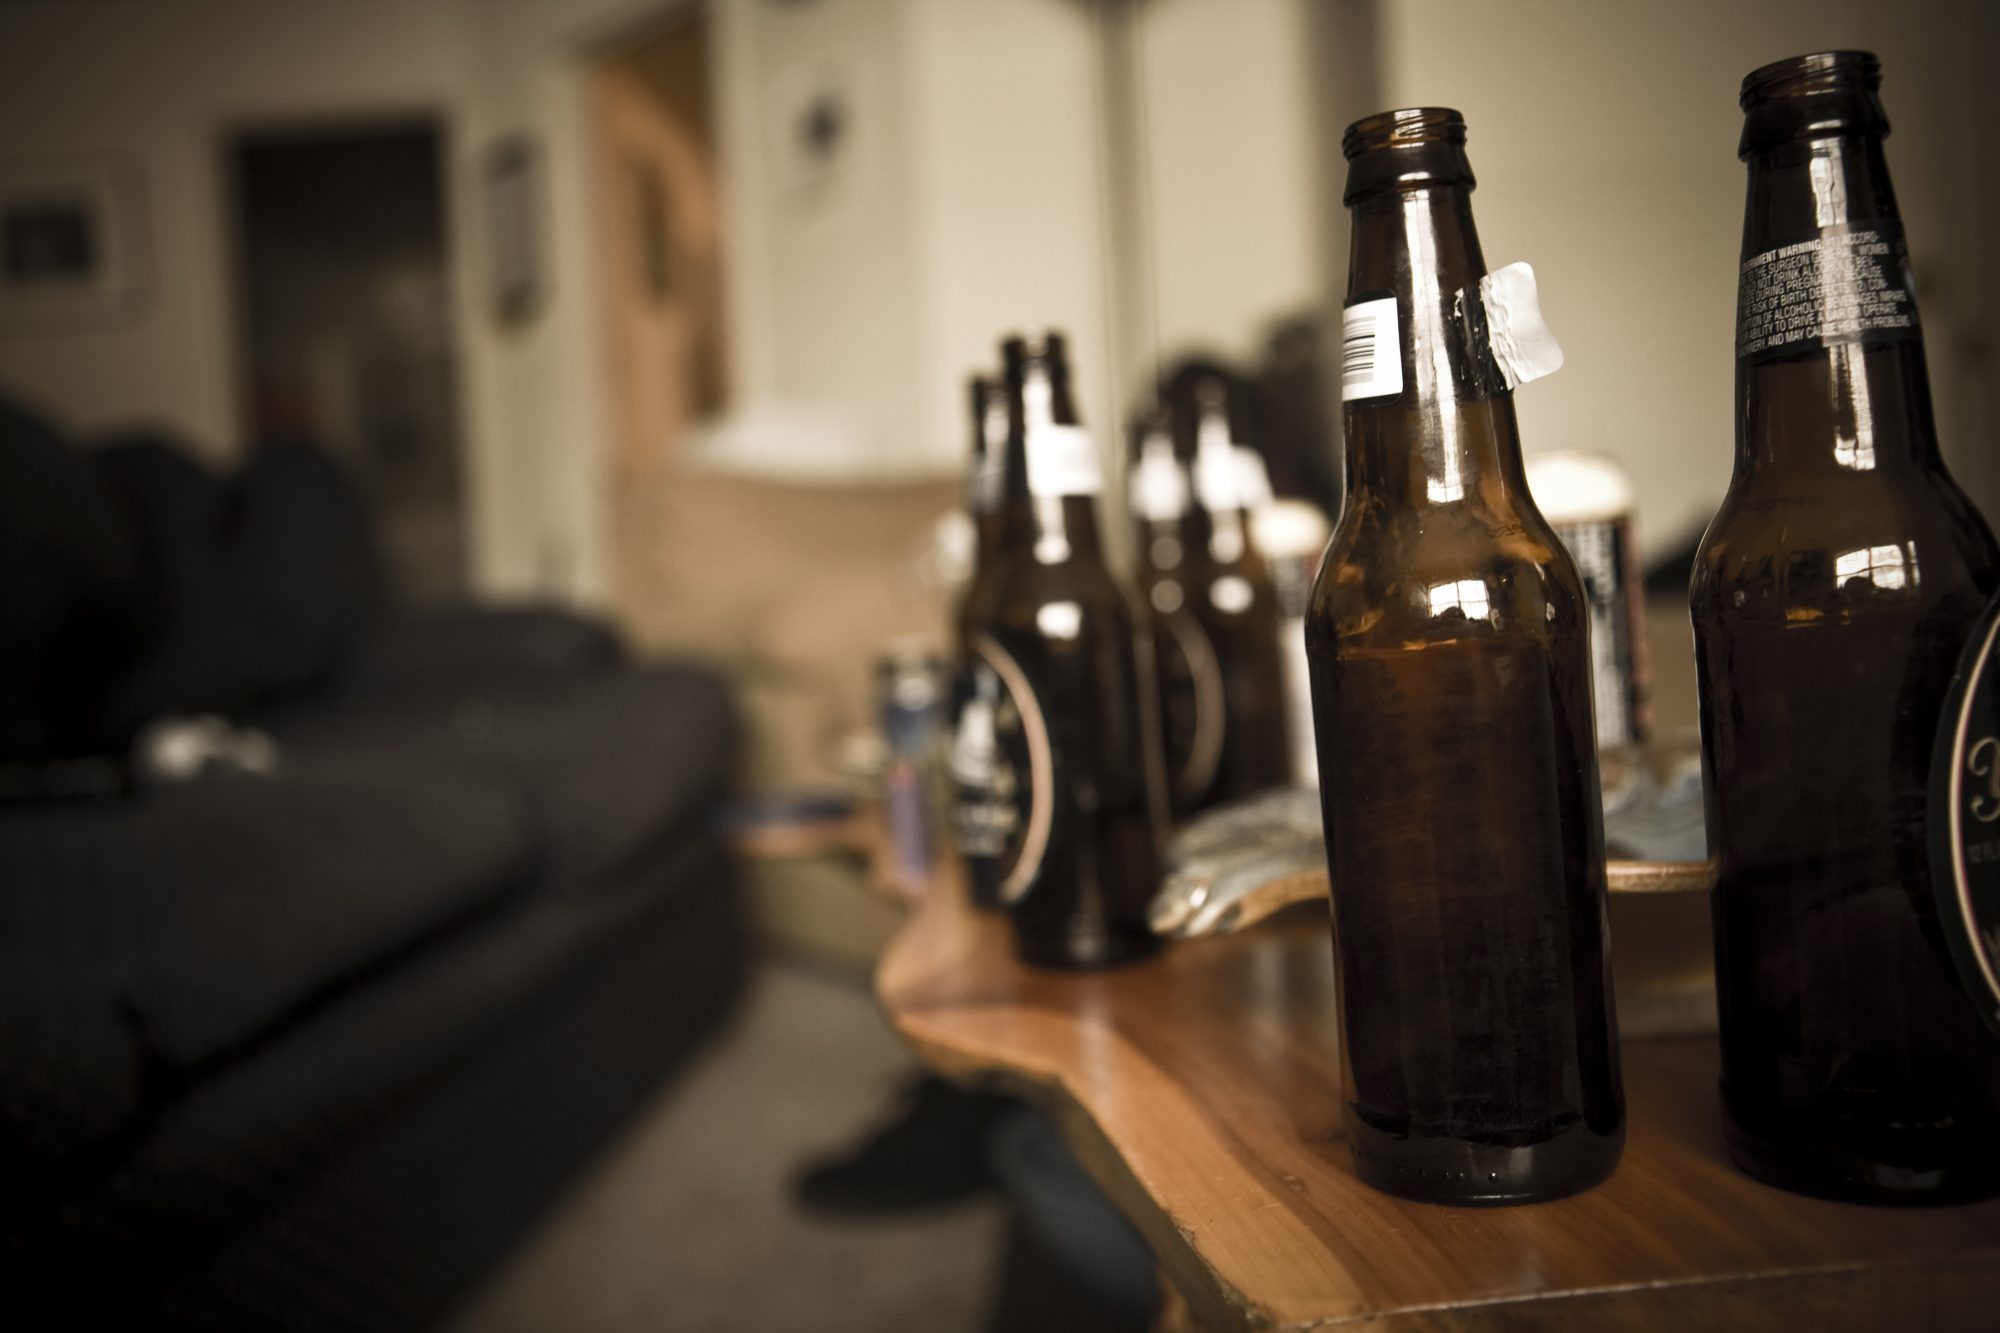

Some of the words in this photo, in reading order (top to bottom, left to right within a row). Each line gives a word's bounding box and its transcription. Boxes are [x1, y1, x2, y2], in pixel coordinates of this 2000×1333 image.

[1768, 254, 1810, 274] SURGEON
[1757, 275, 1771, 289] NOT
[1773, 267, 1800, 285] DRINK
[1752, 300, 1767, 314] RISK
[1768, 296, 1779, 309] OF
[1780, 290, 1807, 306] BIRTH
[1755, 282, 1784, 301] DURING
[1749, 323, 1774, 339] ABILITY
[1775, 319, 1786, 332] TO
[1788, 313, 1815, 329] DRIVE
[1817, 311, 1824, 322] A
[1847, 305, 1862, 318] OR
[1763, 310, 1773, 324] OF
[1774, 299, 1824, 320] ALCOHOLIC
[1767, 333, 1784, 347] AND
[1785, 328, 1804, 343] MAY
